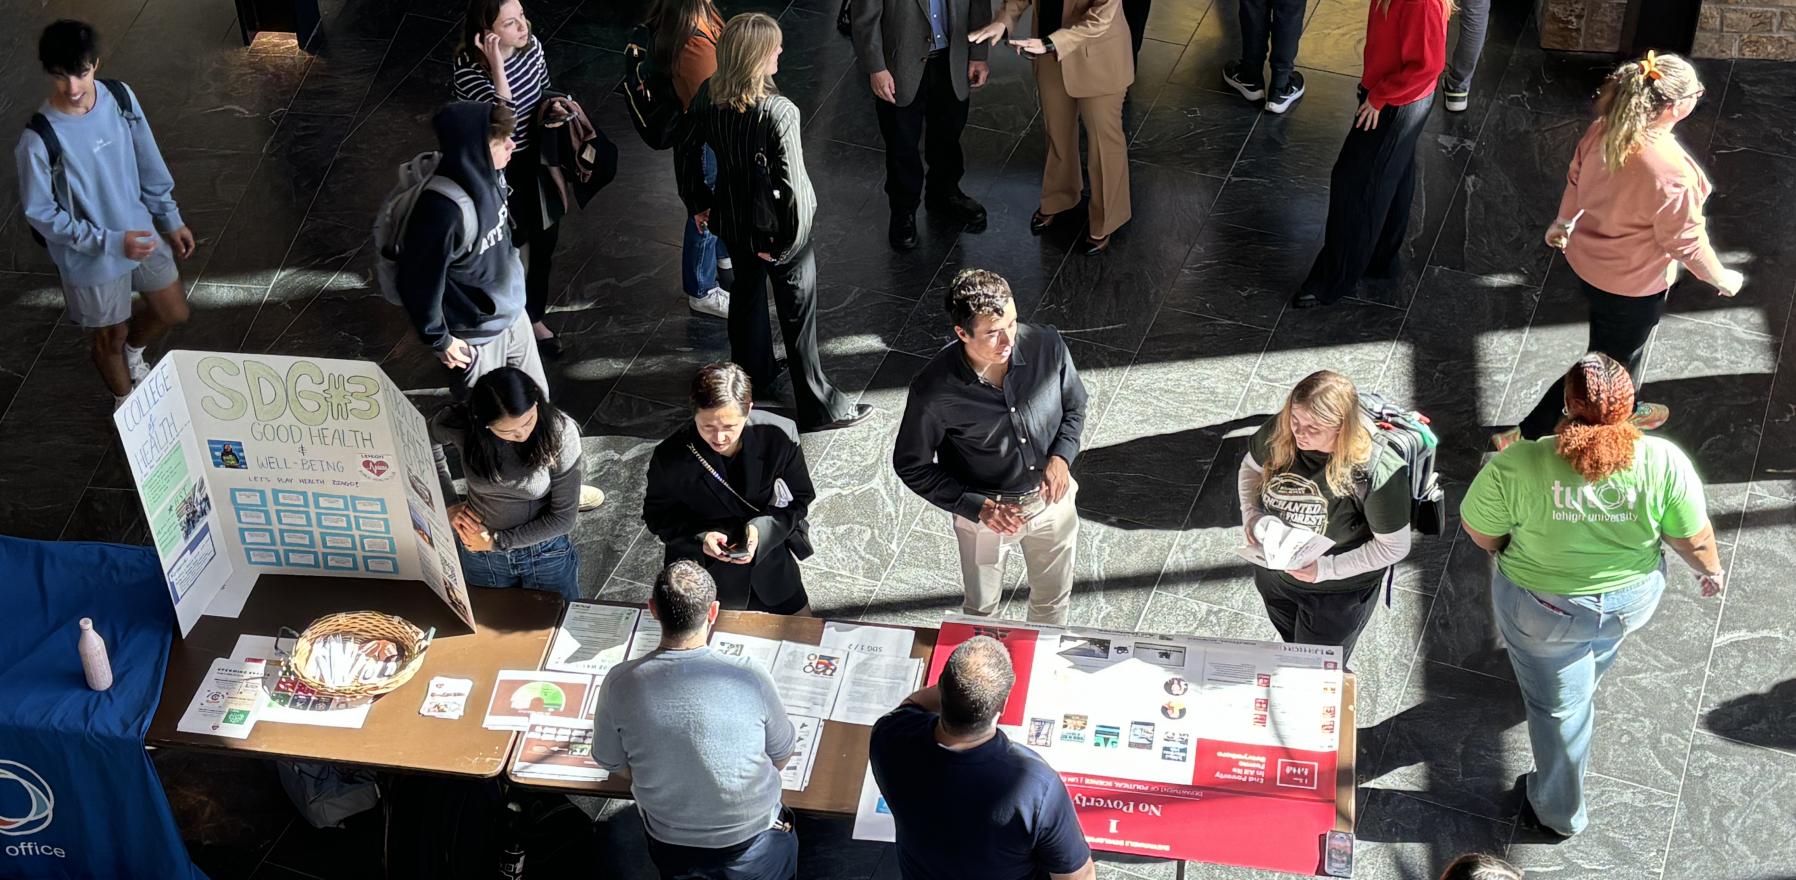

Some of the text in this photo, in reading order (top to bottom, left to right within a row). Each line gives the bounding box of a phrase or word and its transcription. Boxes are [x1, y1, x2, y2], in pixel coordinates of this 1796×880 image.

[123, 363, 172, 433] COLLEGE
[197, 356, 381, 427] SDG#3
[135, 411, 178, 474] HEALTH
[250, 422, 375, 449] GOOD HEALTH
[1552, 480, 1637, 509] tutor
[1285, 511, 1326, 526] FOREST
[1074, 793, 1162, 817] No Poverty
[1108, 819, 1119, 833] 1
[5, 842, 66, 858] office
